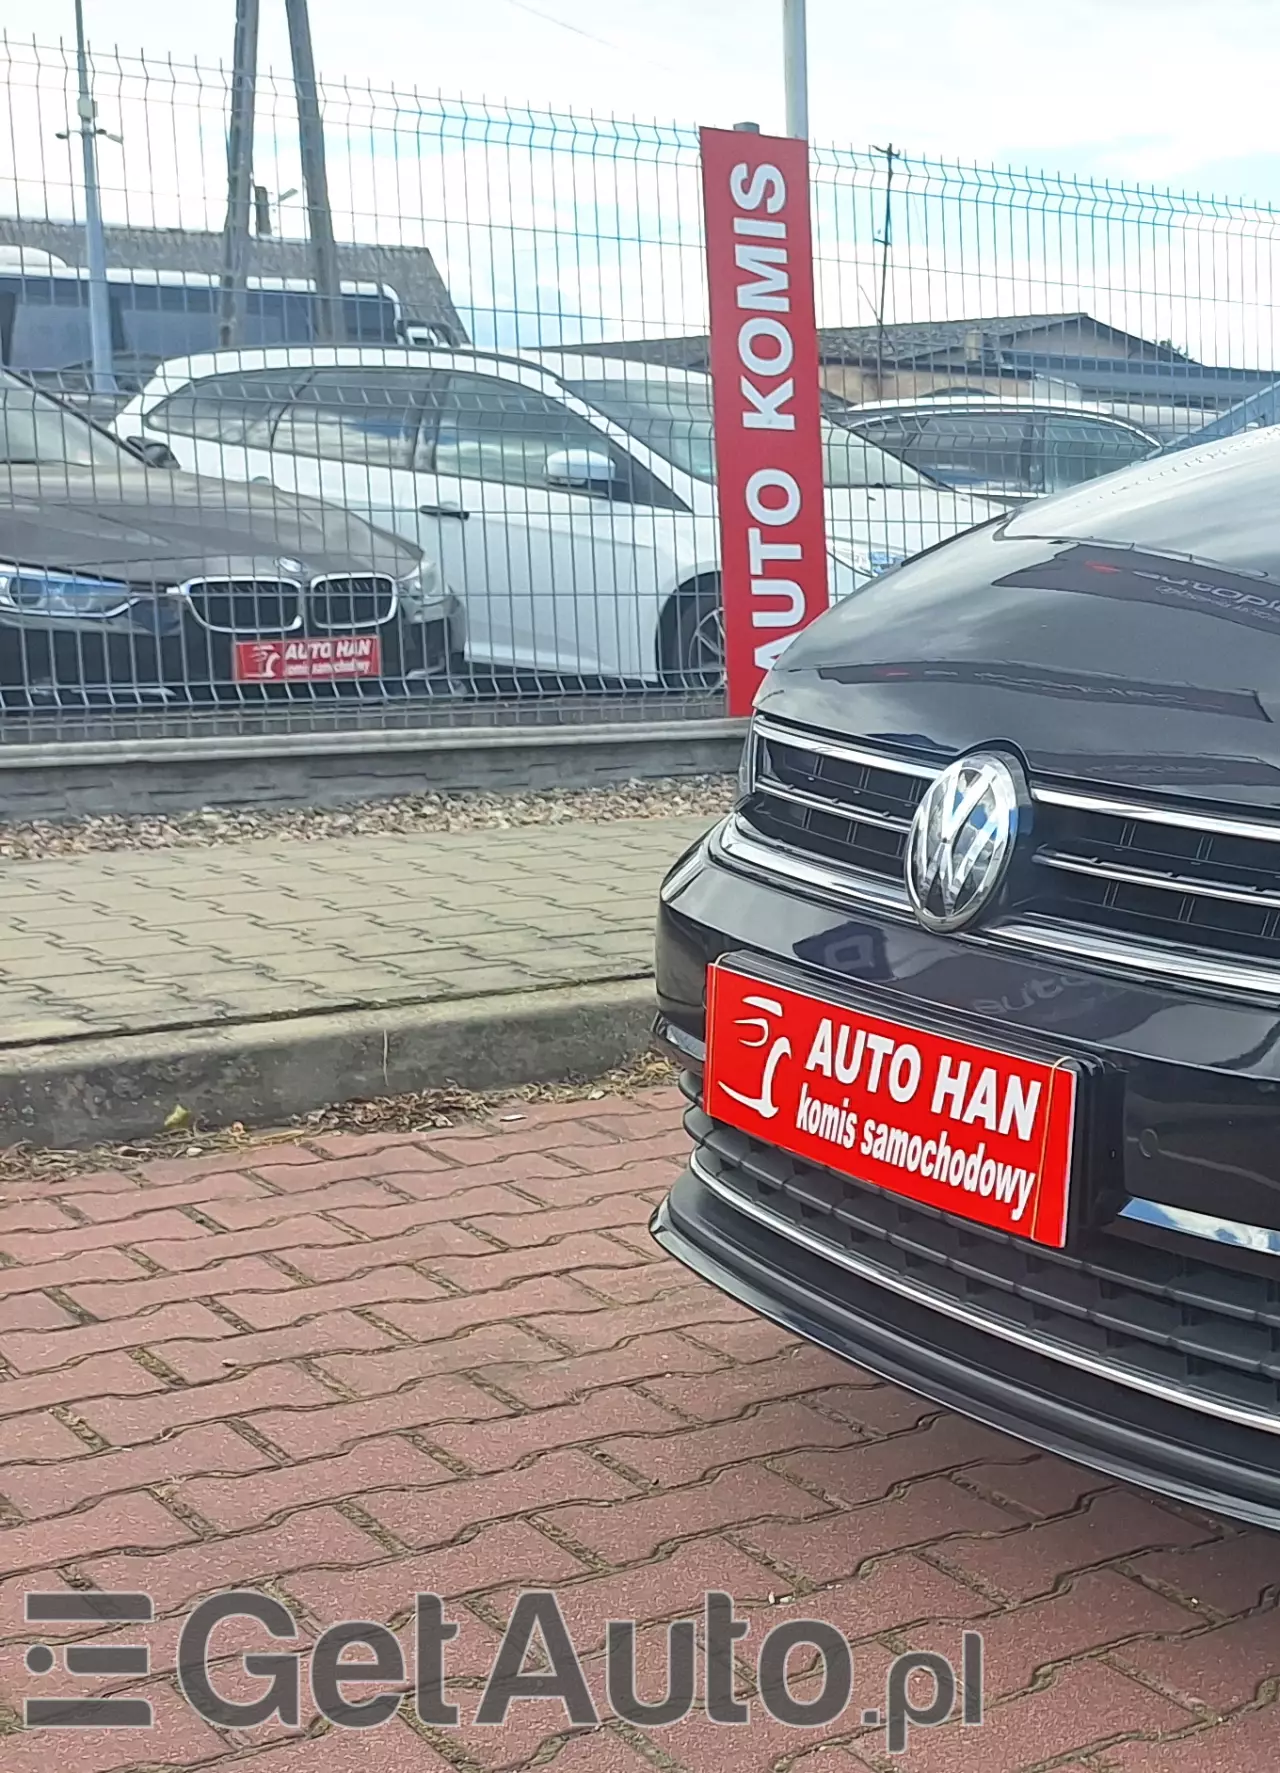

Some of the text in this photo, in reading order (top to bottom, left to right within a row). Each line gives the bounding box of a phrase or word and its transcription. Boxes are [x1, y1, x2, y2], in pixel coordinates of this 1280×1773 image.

[729, 162, 796, 431] KOMIS
[285, 638, 372, 660] AUTO HAN
[805, 1018, 1042, 1142] AUTO HAN
[796, 1082, 1036, 1221] komis samochodowy
